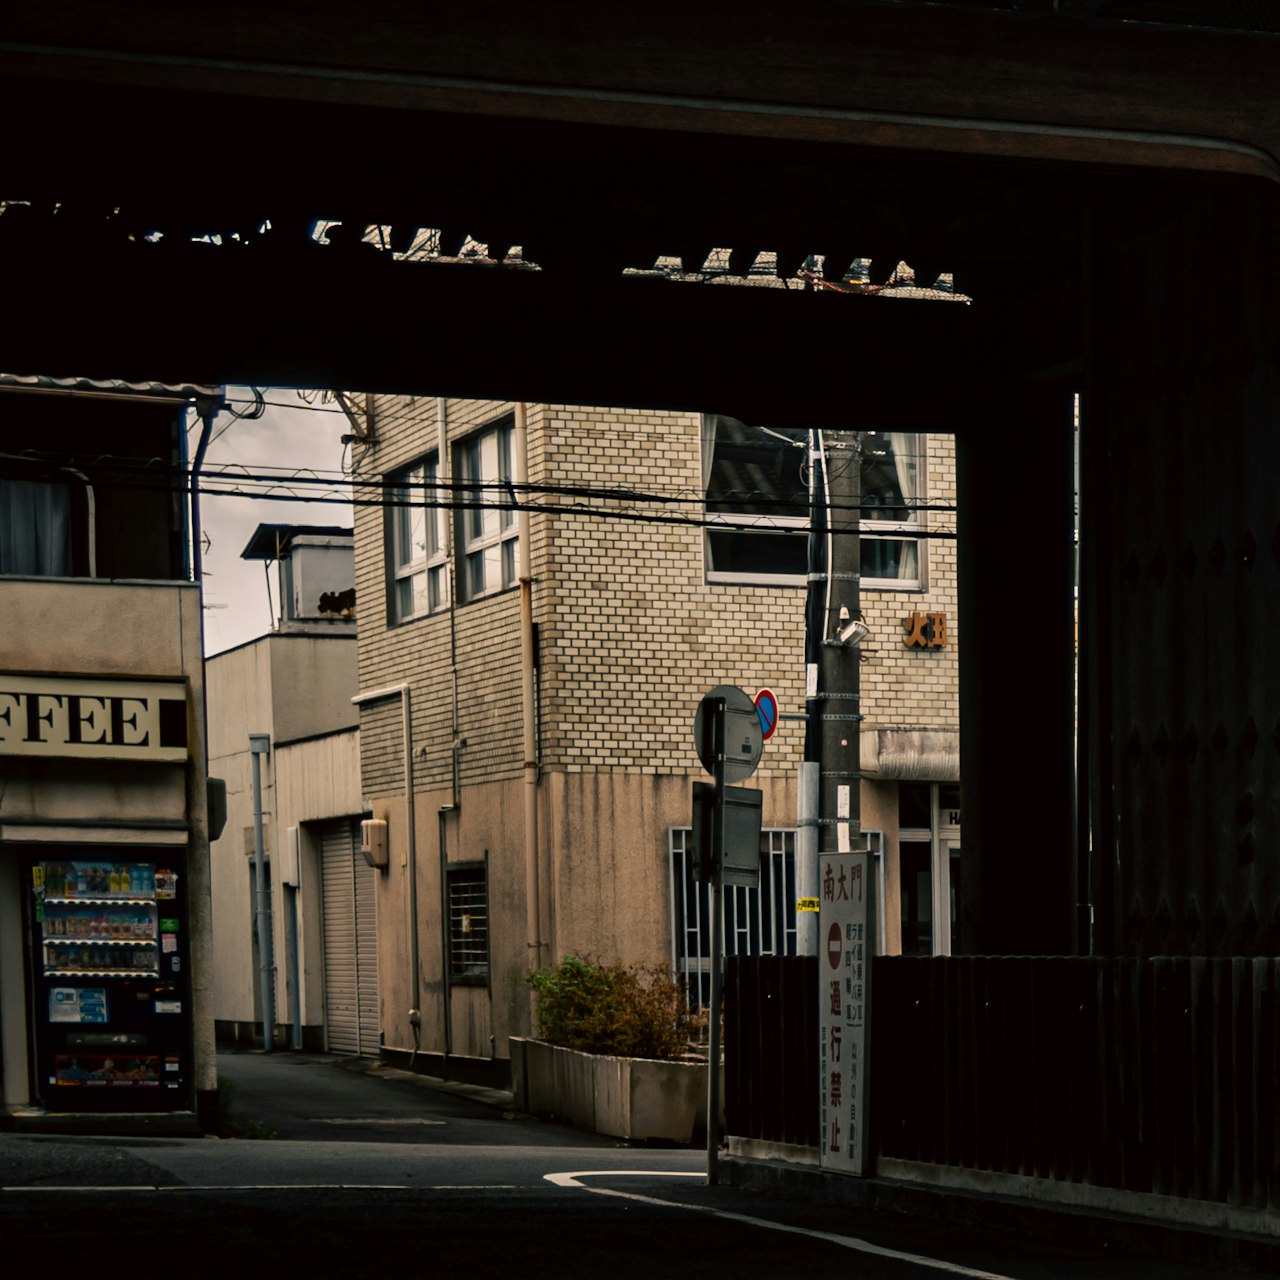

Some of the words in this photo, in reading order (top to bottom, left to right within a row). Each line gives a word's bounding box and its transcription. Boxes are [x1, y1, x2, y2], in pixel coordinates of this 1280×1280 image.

[903, 612, 948, 649] 畑
[823, 862, 863, 903] 南大門
[830, 980, 842, 1153] 通行禁止
